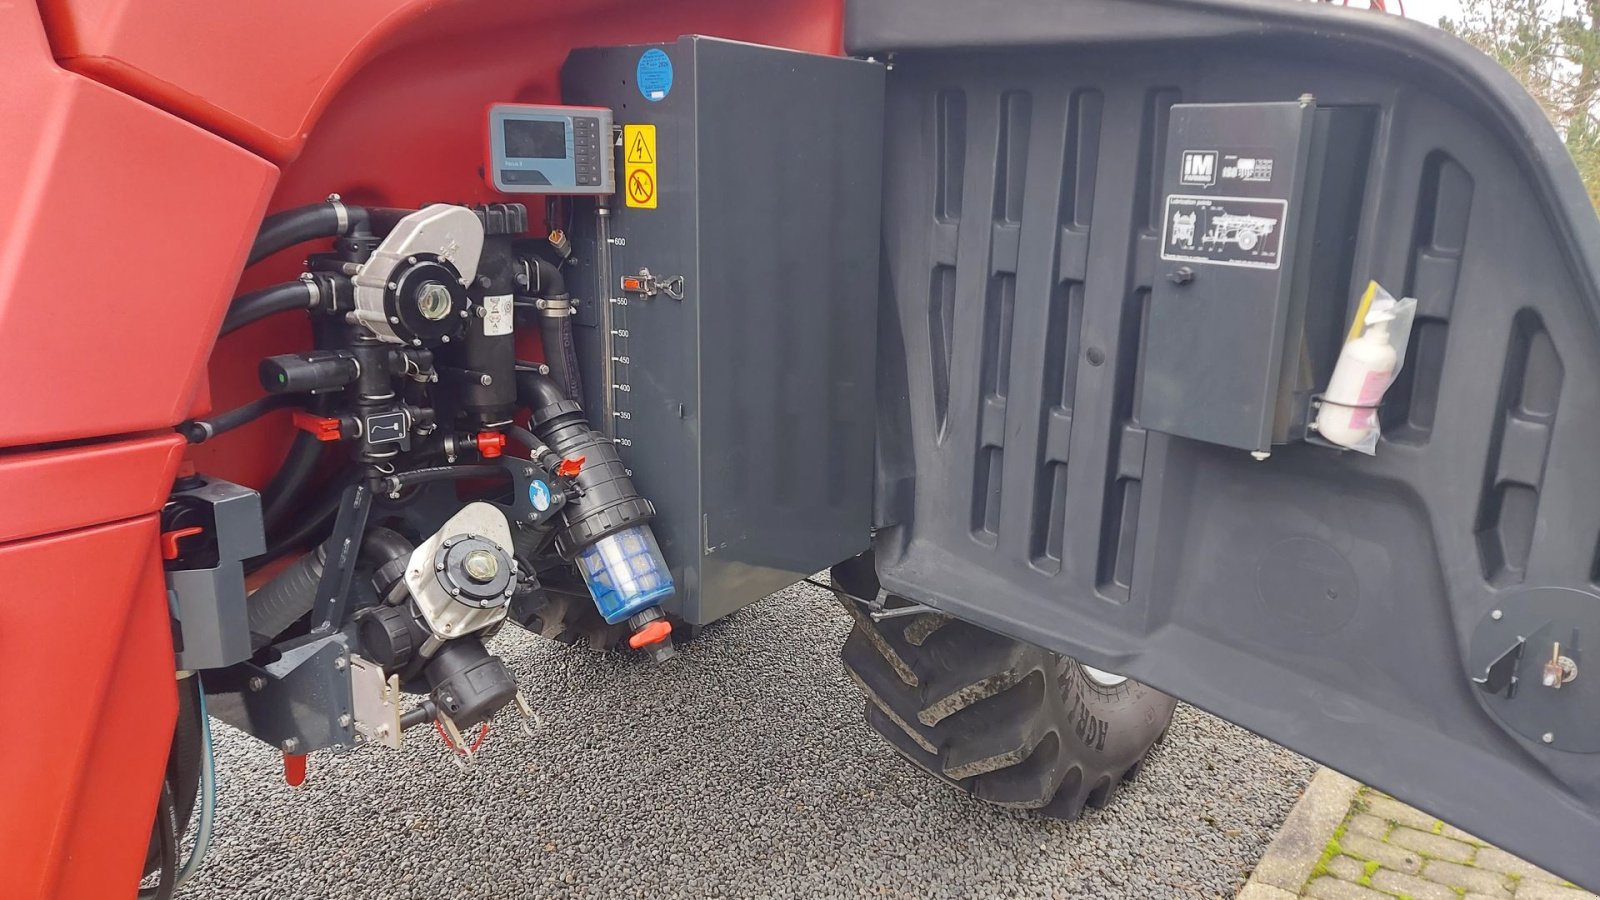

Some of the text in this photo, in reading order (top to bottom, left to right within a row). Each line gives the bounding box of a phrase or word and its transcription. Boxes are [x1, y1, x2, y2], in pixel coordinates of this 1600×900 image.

[614, 237, 626, 246] 600
[616, 297, 628, 306] 550
[617, 329, 629, 337] 500
[619, 356, 630, 365] 450
[619, 384, 631, 392] 400
[620, 411, 631, 420] 350
[620, 438, 632, 447] 300
